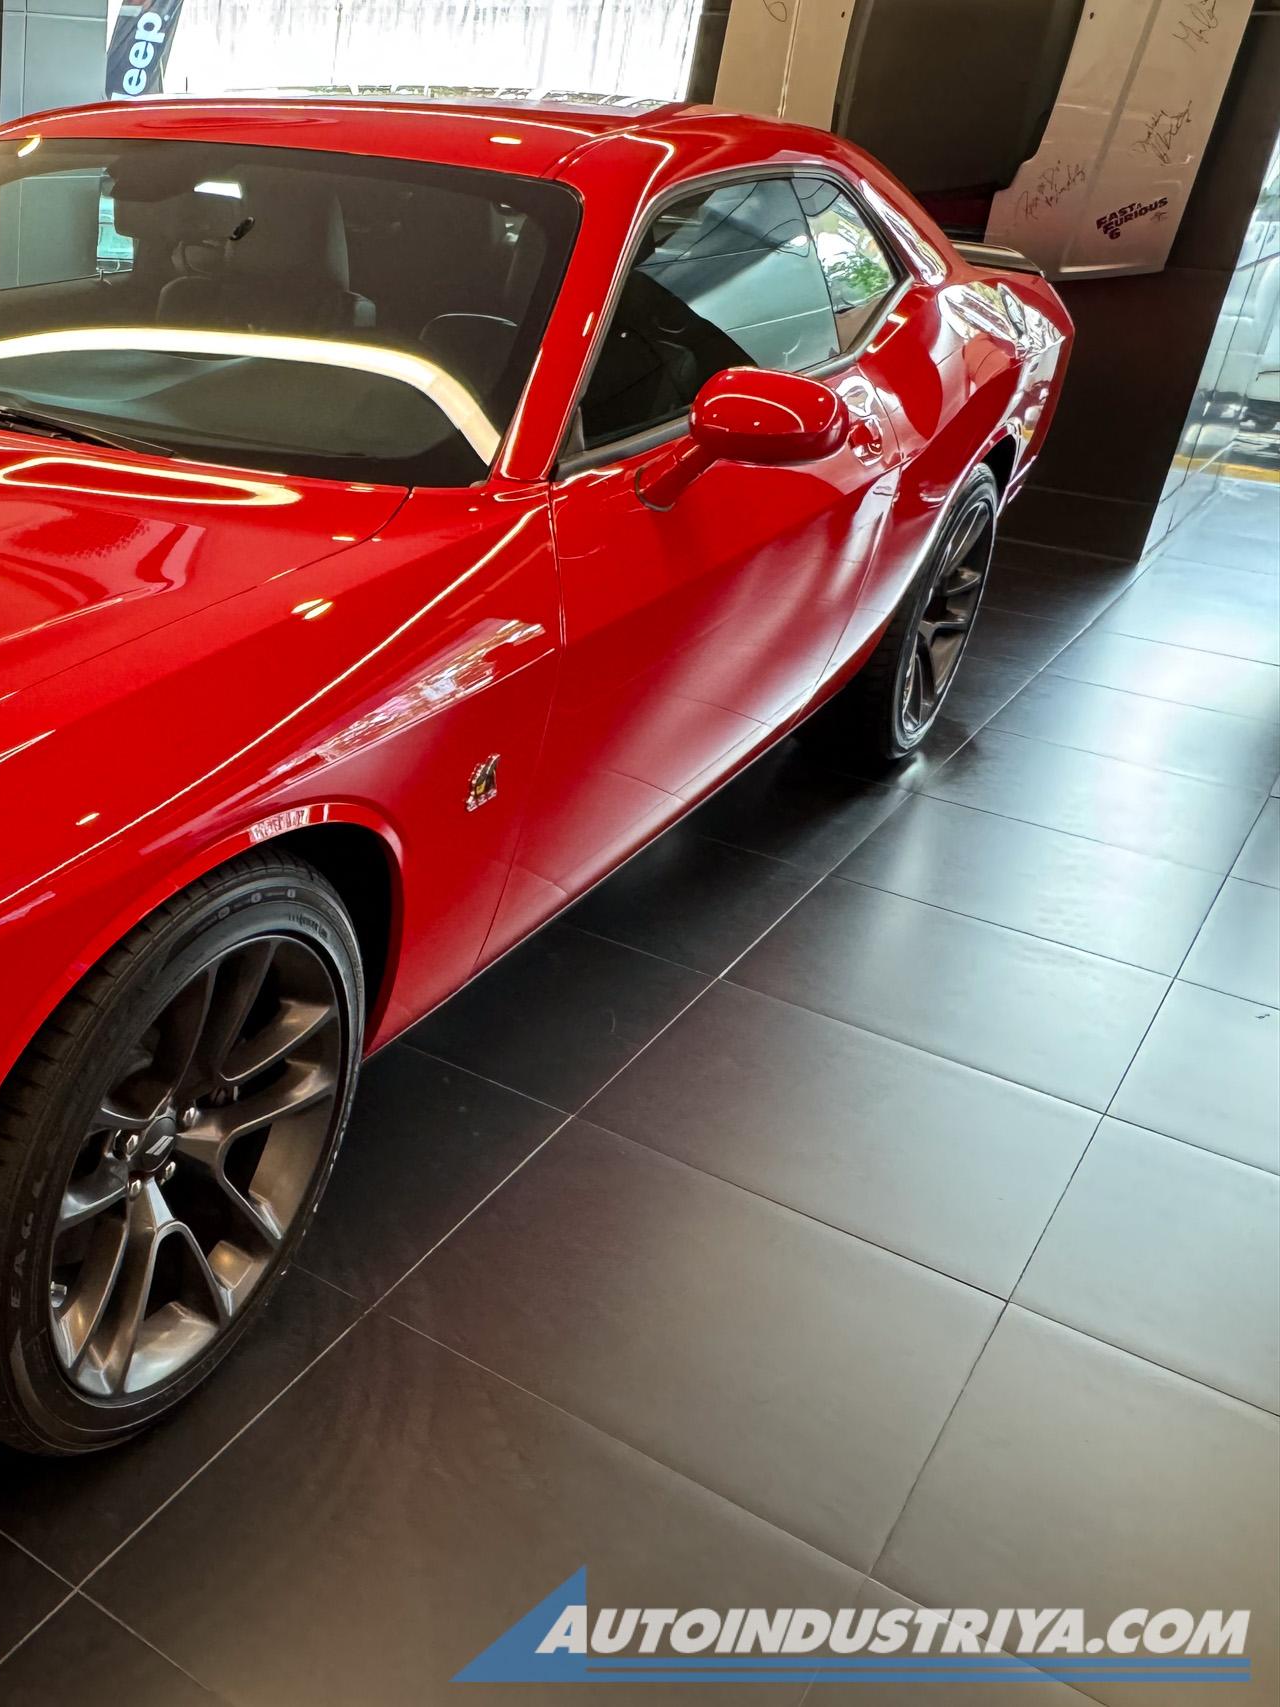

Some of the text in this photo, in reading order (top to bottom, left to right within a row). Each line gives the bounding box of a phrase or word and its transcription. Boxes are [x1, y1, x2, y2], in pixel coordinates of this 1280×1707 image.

[111, 11, 165, 100] eep
[1096, 202, 1137, 230] FAST
[1103, 197, 1168, 235] FURIOUS
[1109, 227, 1121, 240] 6
